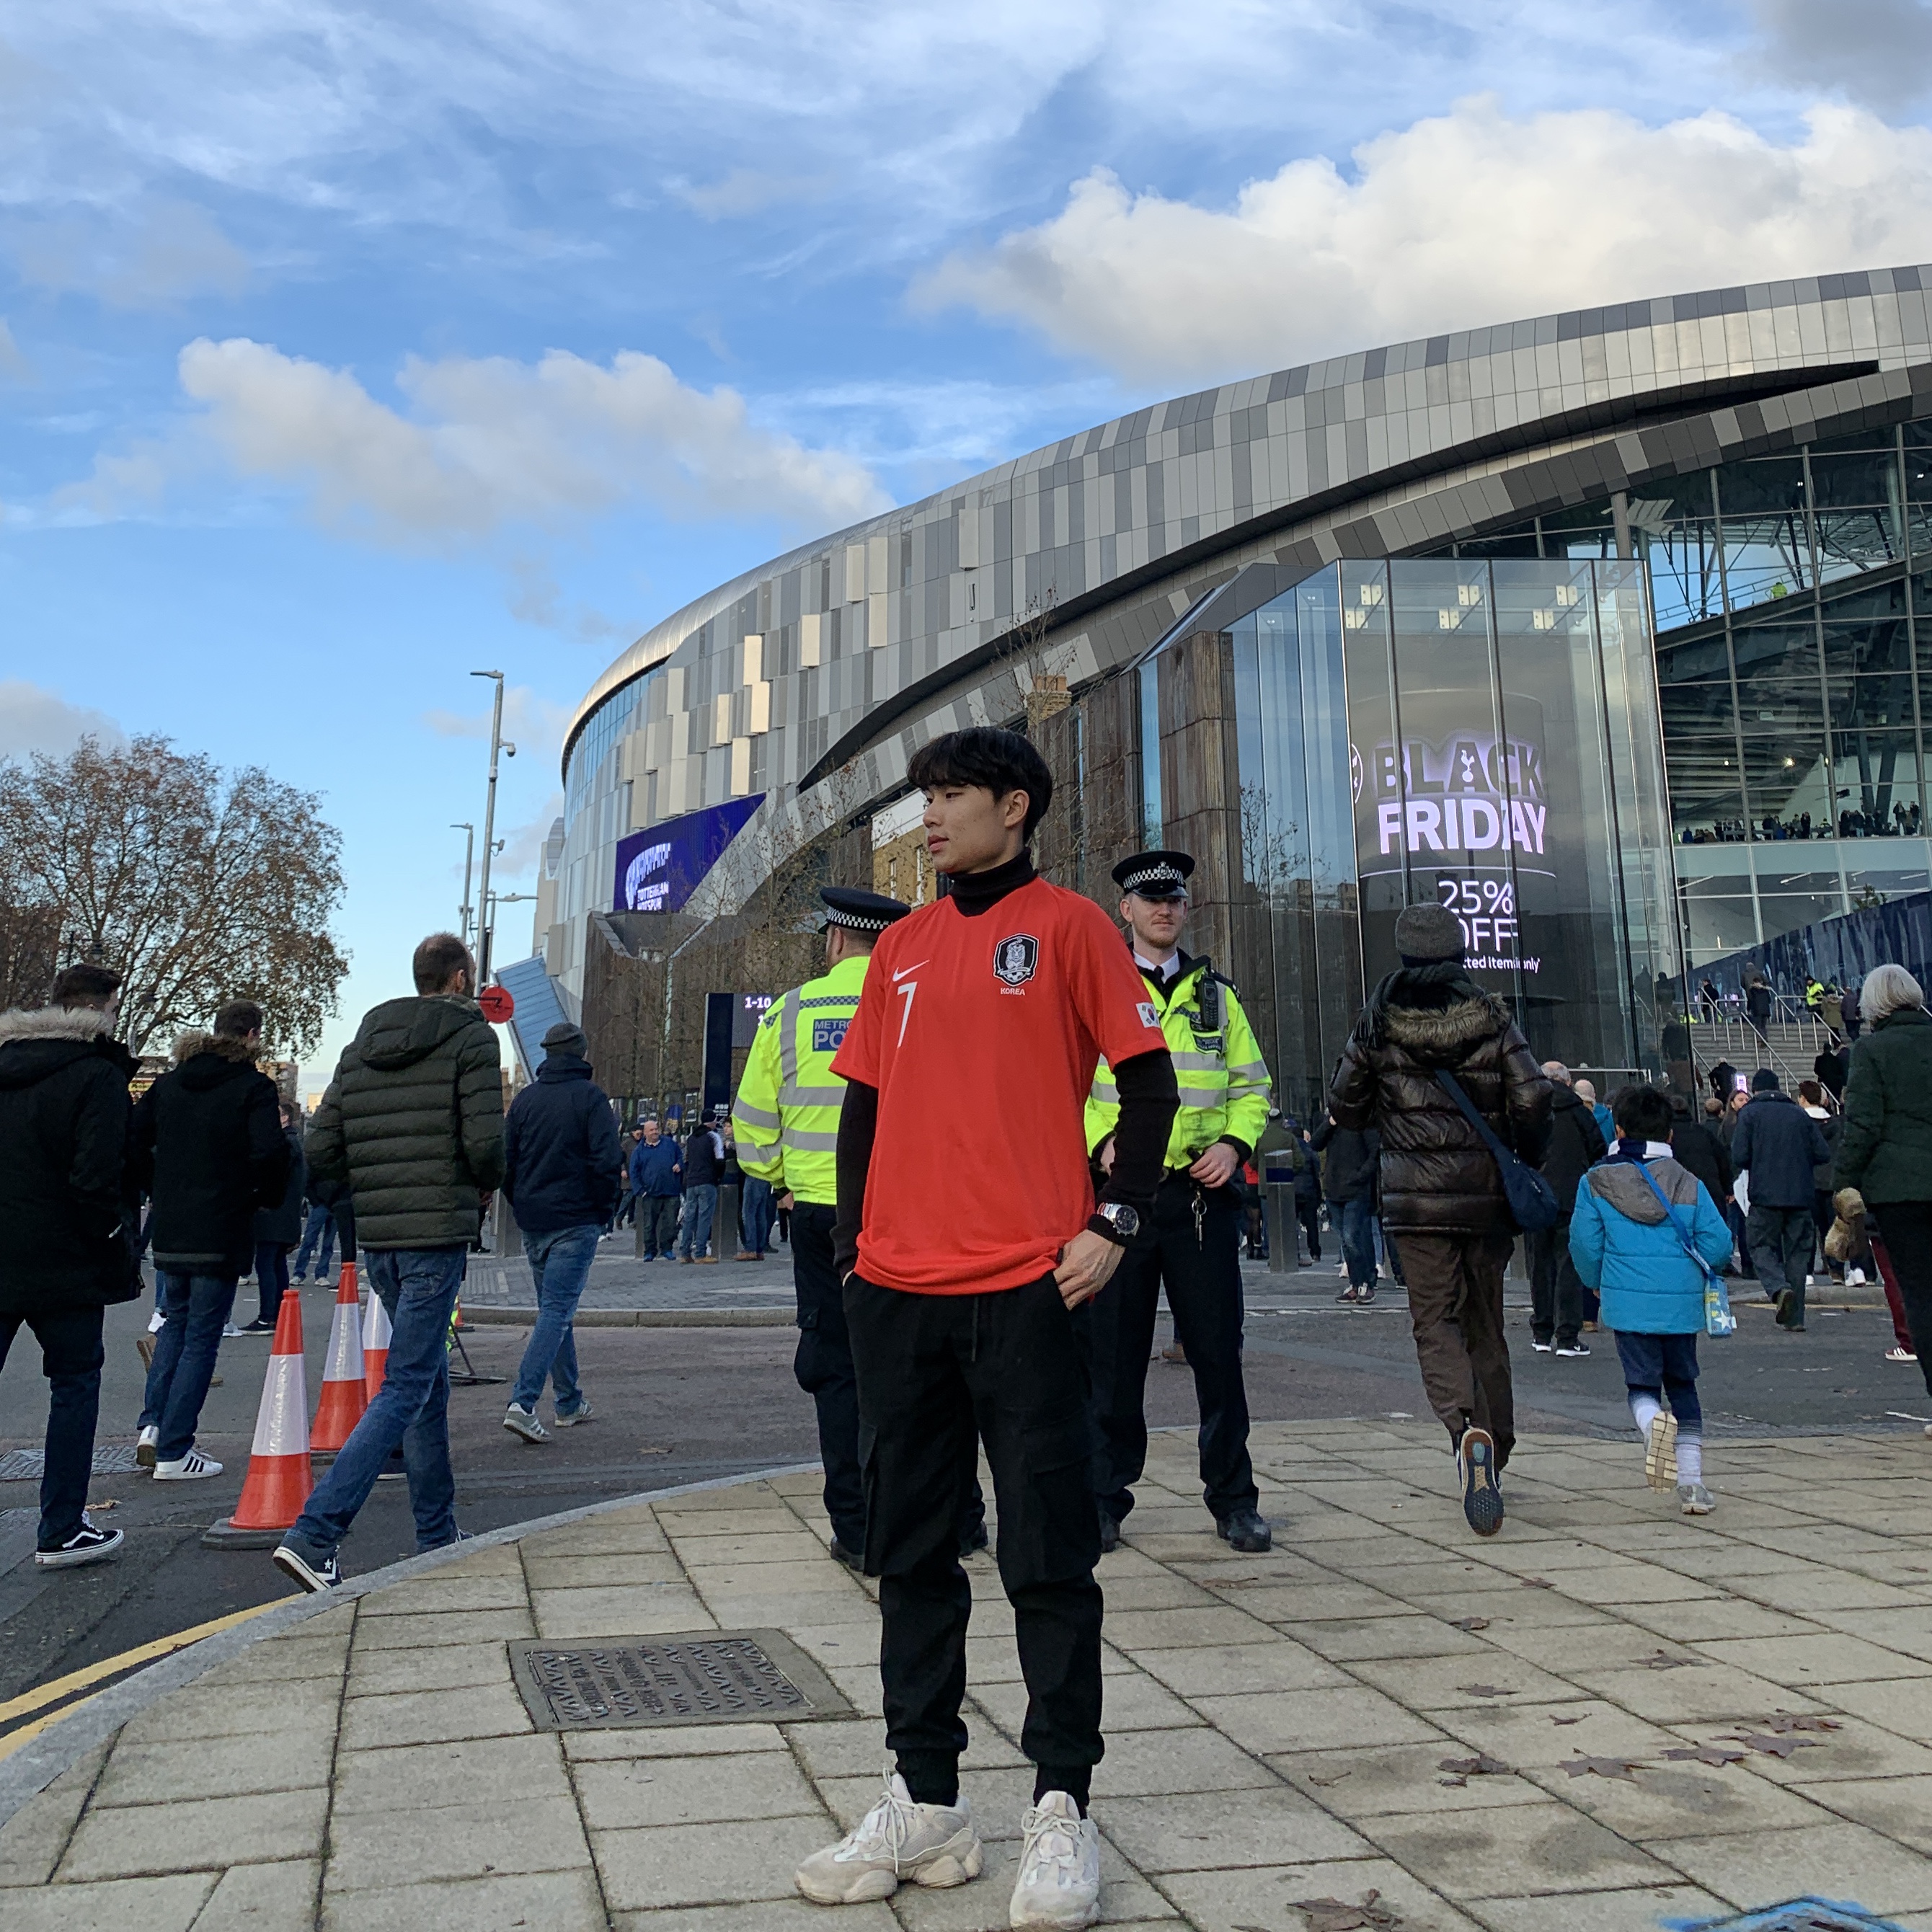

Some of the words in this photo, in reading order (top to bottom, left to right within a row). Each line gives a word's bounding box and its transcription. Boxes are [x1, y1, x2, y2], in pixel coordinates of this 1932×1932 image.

[1374, 741, 1544, 799] BLACK
[1378, 799, 1546, 855] FRIDAY
[1437, 879, 1514, 914] 25%
[745, 996, 772, 1009] 1-10
[1000, 987, 1025, 996] KOREA
[897, 981, 918, 1049] 7
